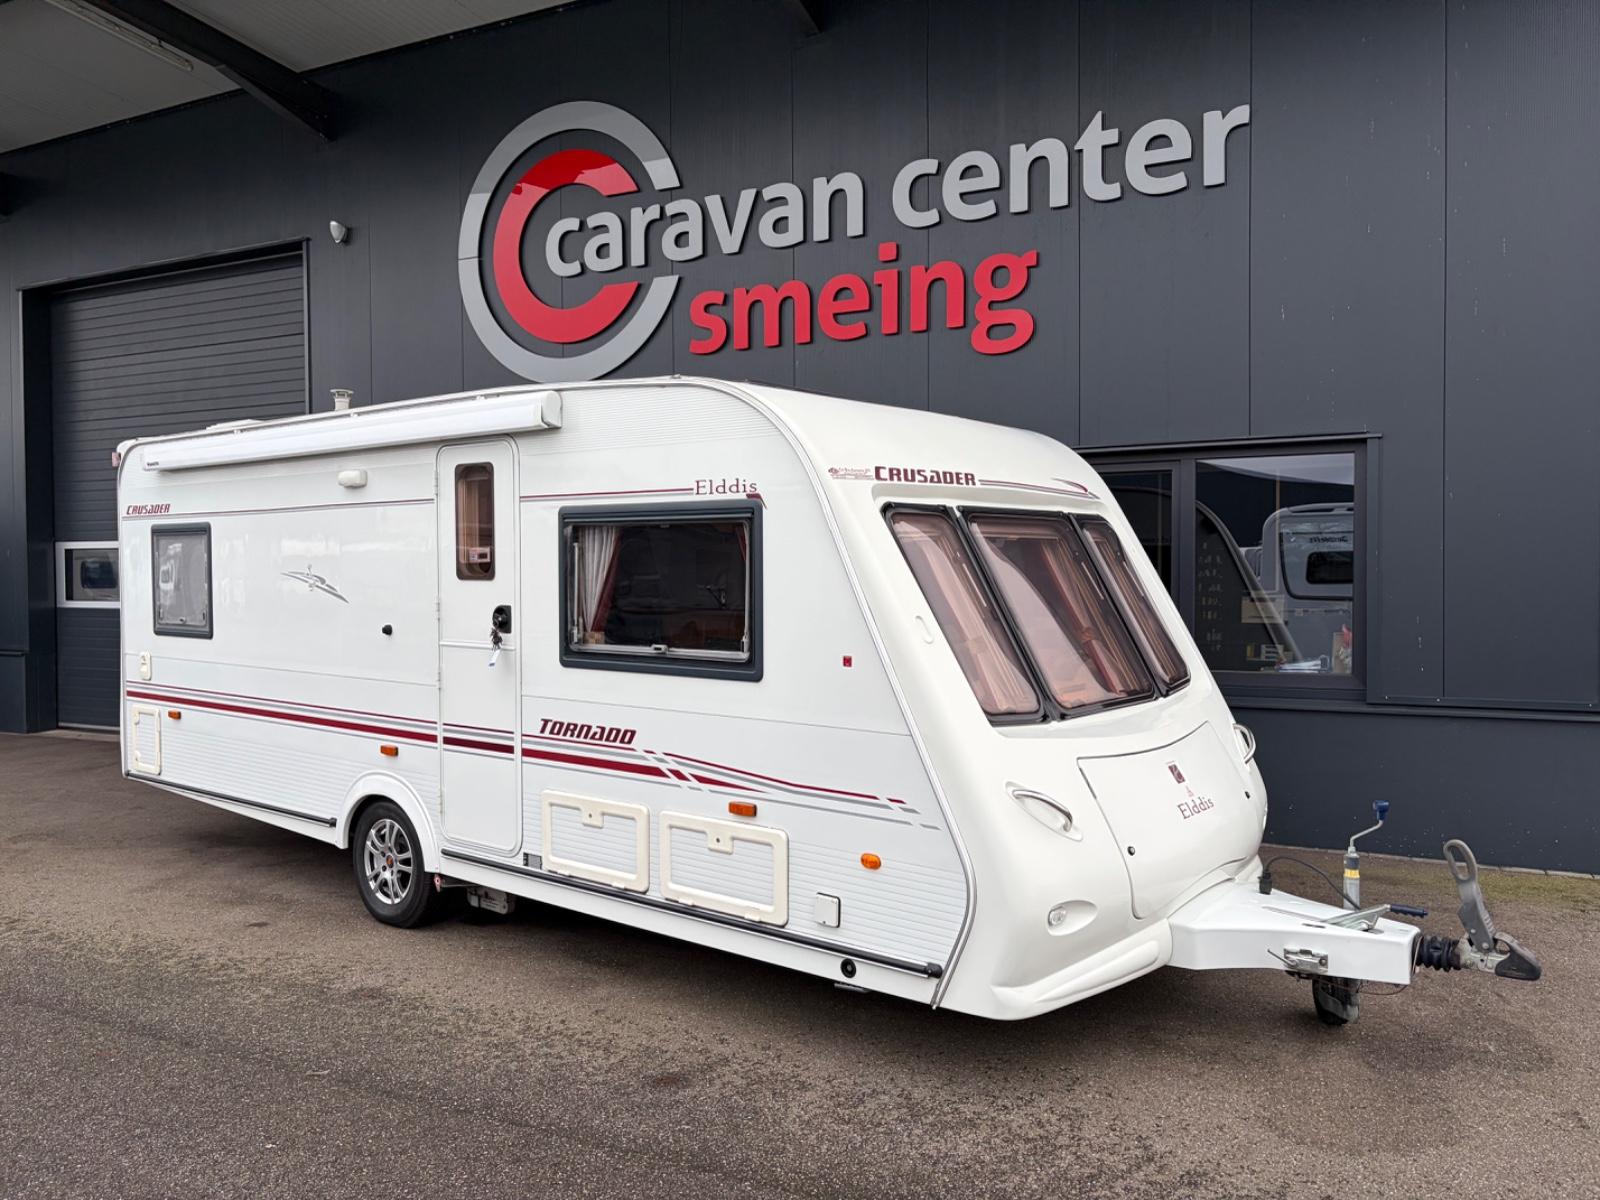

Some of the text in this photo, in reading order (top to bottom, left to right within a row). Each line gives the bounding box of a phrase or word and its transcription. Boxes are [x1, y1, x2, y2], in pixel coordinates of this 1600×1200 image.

[546, 105, 1250, 277] caravan center
[690, 242, 1038, 355] smeing
[695, 478, 757, 495] Elddis
[875, 466, 976, 485] CRUSADER
[126, 503, 171, 515] CRUSADER
[540, 718, 637, 745] TORNADO
[1177, 797, 1214, 819] Elddis
